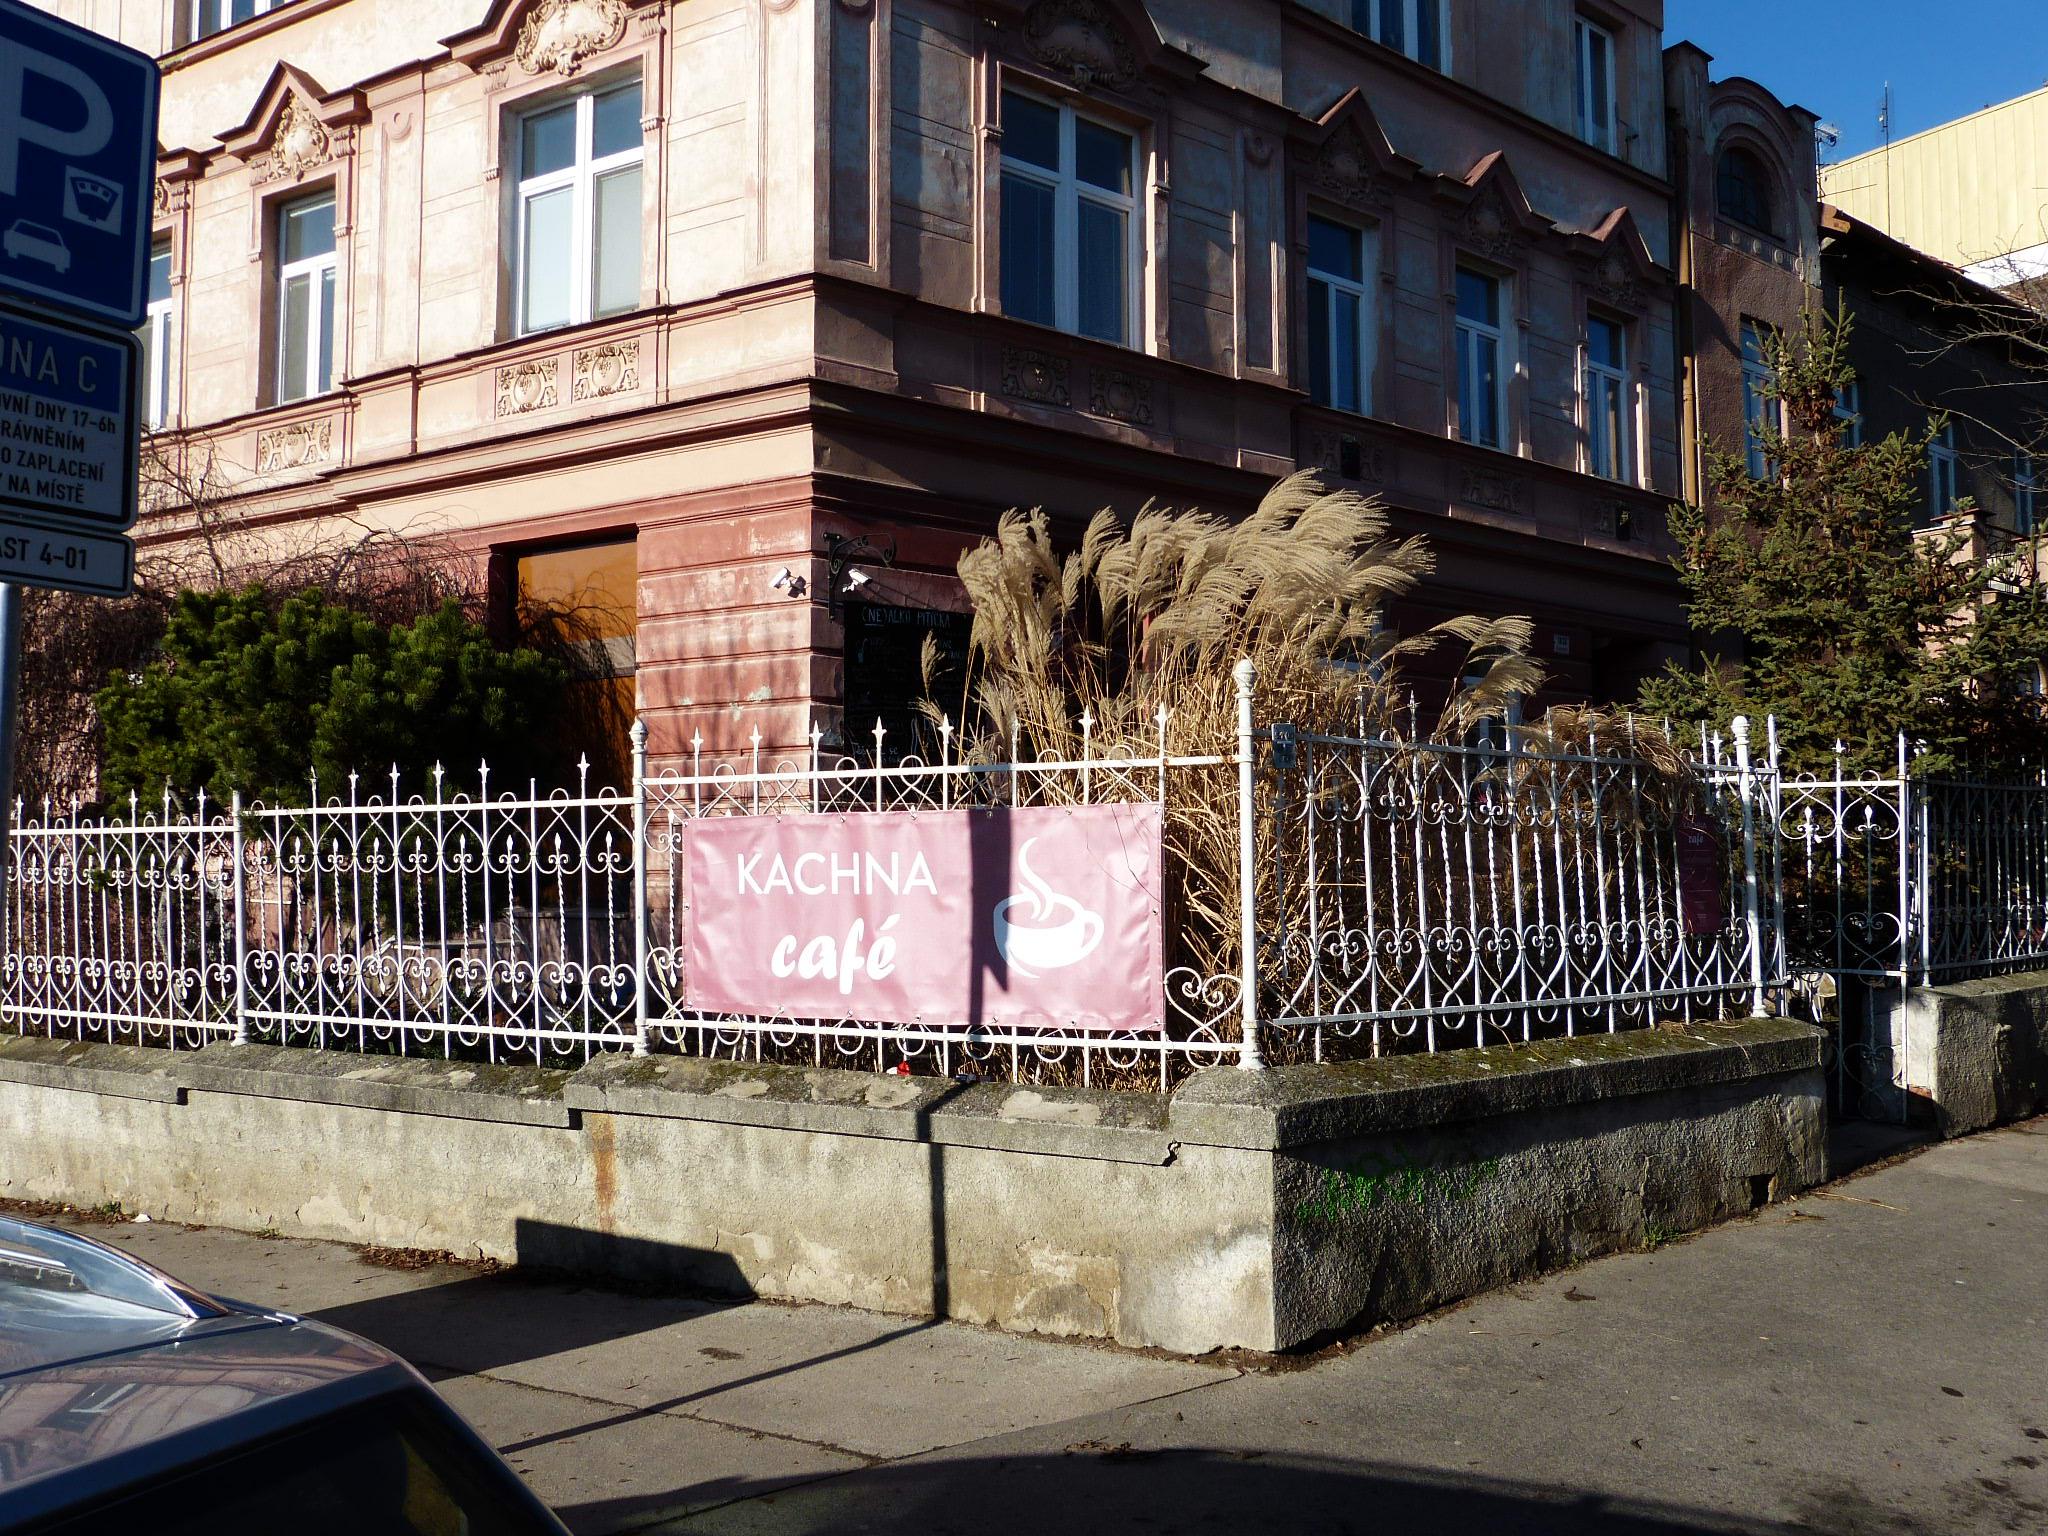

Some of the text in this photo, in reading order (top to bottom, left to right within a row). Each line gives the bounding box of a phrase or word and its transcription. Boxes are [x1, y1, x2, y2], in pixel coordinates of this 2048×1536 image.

[0, 35, 114, 196] P
[0, 332, 97, 393] NA C
[0, 393, 116, 434] VNÍ DNY 17-6h
[17, 449, 105, 482] ZAPLACENÍ
[8, 474, 85, 504] NA MÍSTĚ
[0, 536, 87, 570] ST 4-01
[738, 852, 938, 896] KACHNA
[771, 913, 901, 995] café
